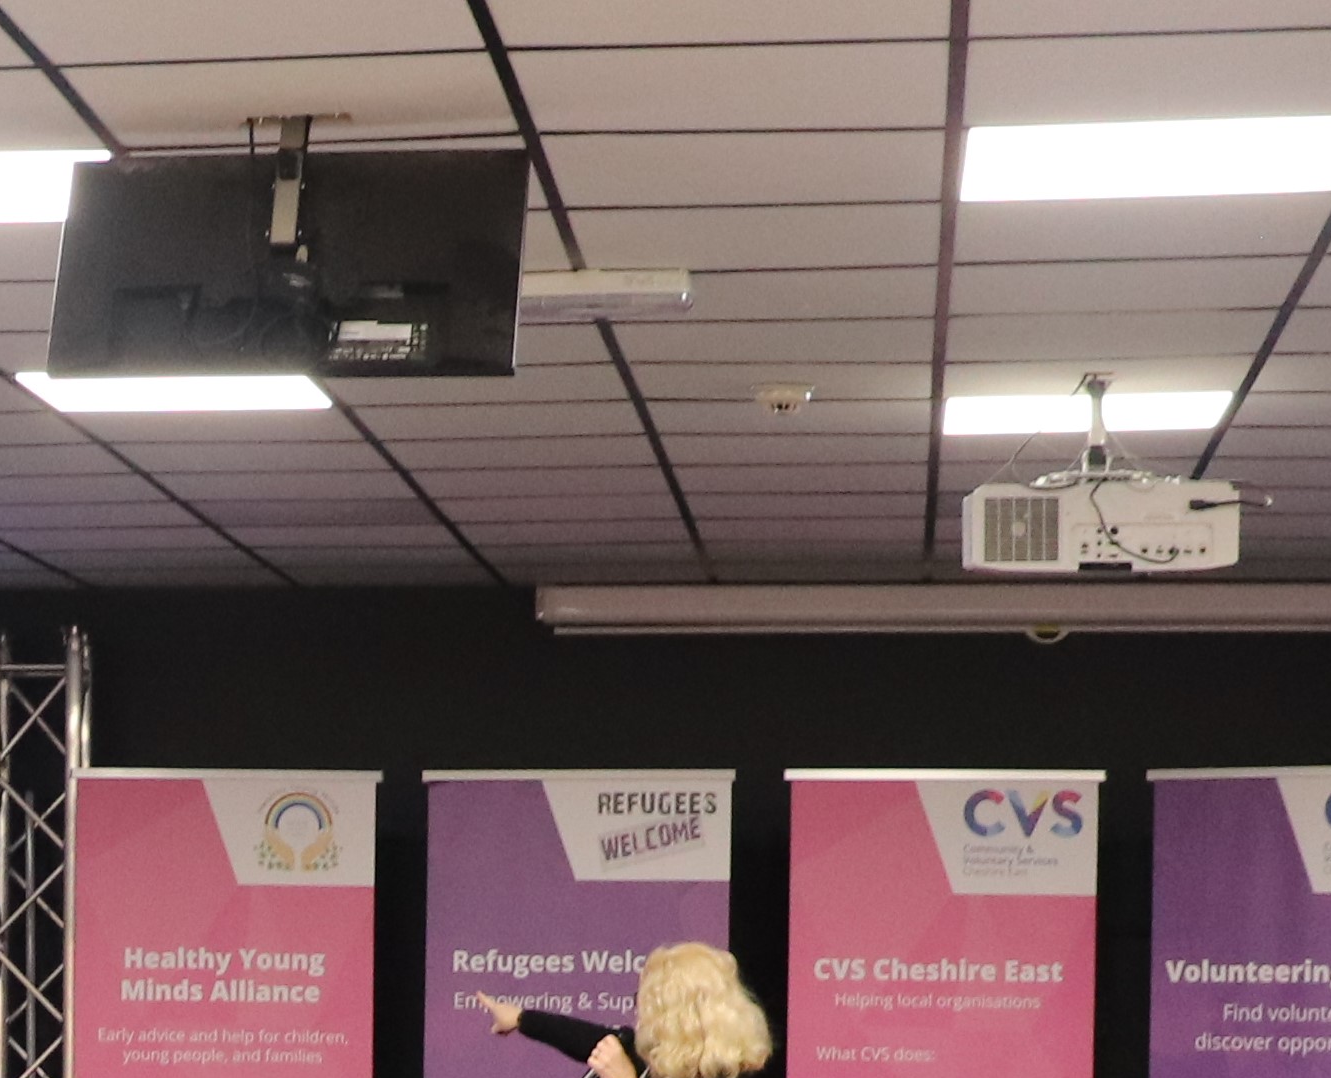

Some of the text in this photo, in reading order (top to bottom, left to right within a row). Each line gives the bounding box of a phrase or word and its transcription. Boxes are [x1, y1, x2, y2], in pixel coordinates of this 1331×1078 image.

[598, 792, 717, 815] REFUGEES
[964, 789, 1083, 838] CVS
[601, 817, 701, 862] WELCOME
[124, 946, 325, 976] Healthy Young
[453, 949, 646, 977] Refugees Welc
[813, 959, 1064, 982] CVS Cheshire East
[120, 978, 320, 1003] Minds Alliance
[454, 992, 636, 1014] Emowering & Sup
[835, 993, 1040, 1011] Helping local organisations
[1223, 1003, 1262, 1022] Find
[98, 1027, 348, 1045] Early advice and help for children,
[1195, 1033, 1271, 1051] discover
[123, 1048, 322, 1065] young people, and families
[816, 1046, 935, 1061] What CVS does:
